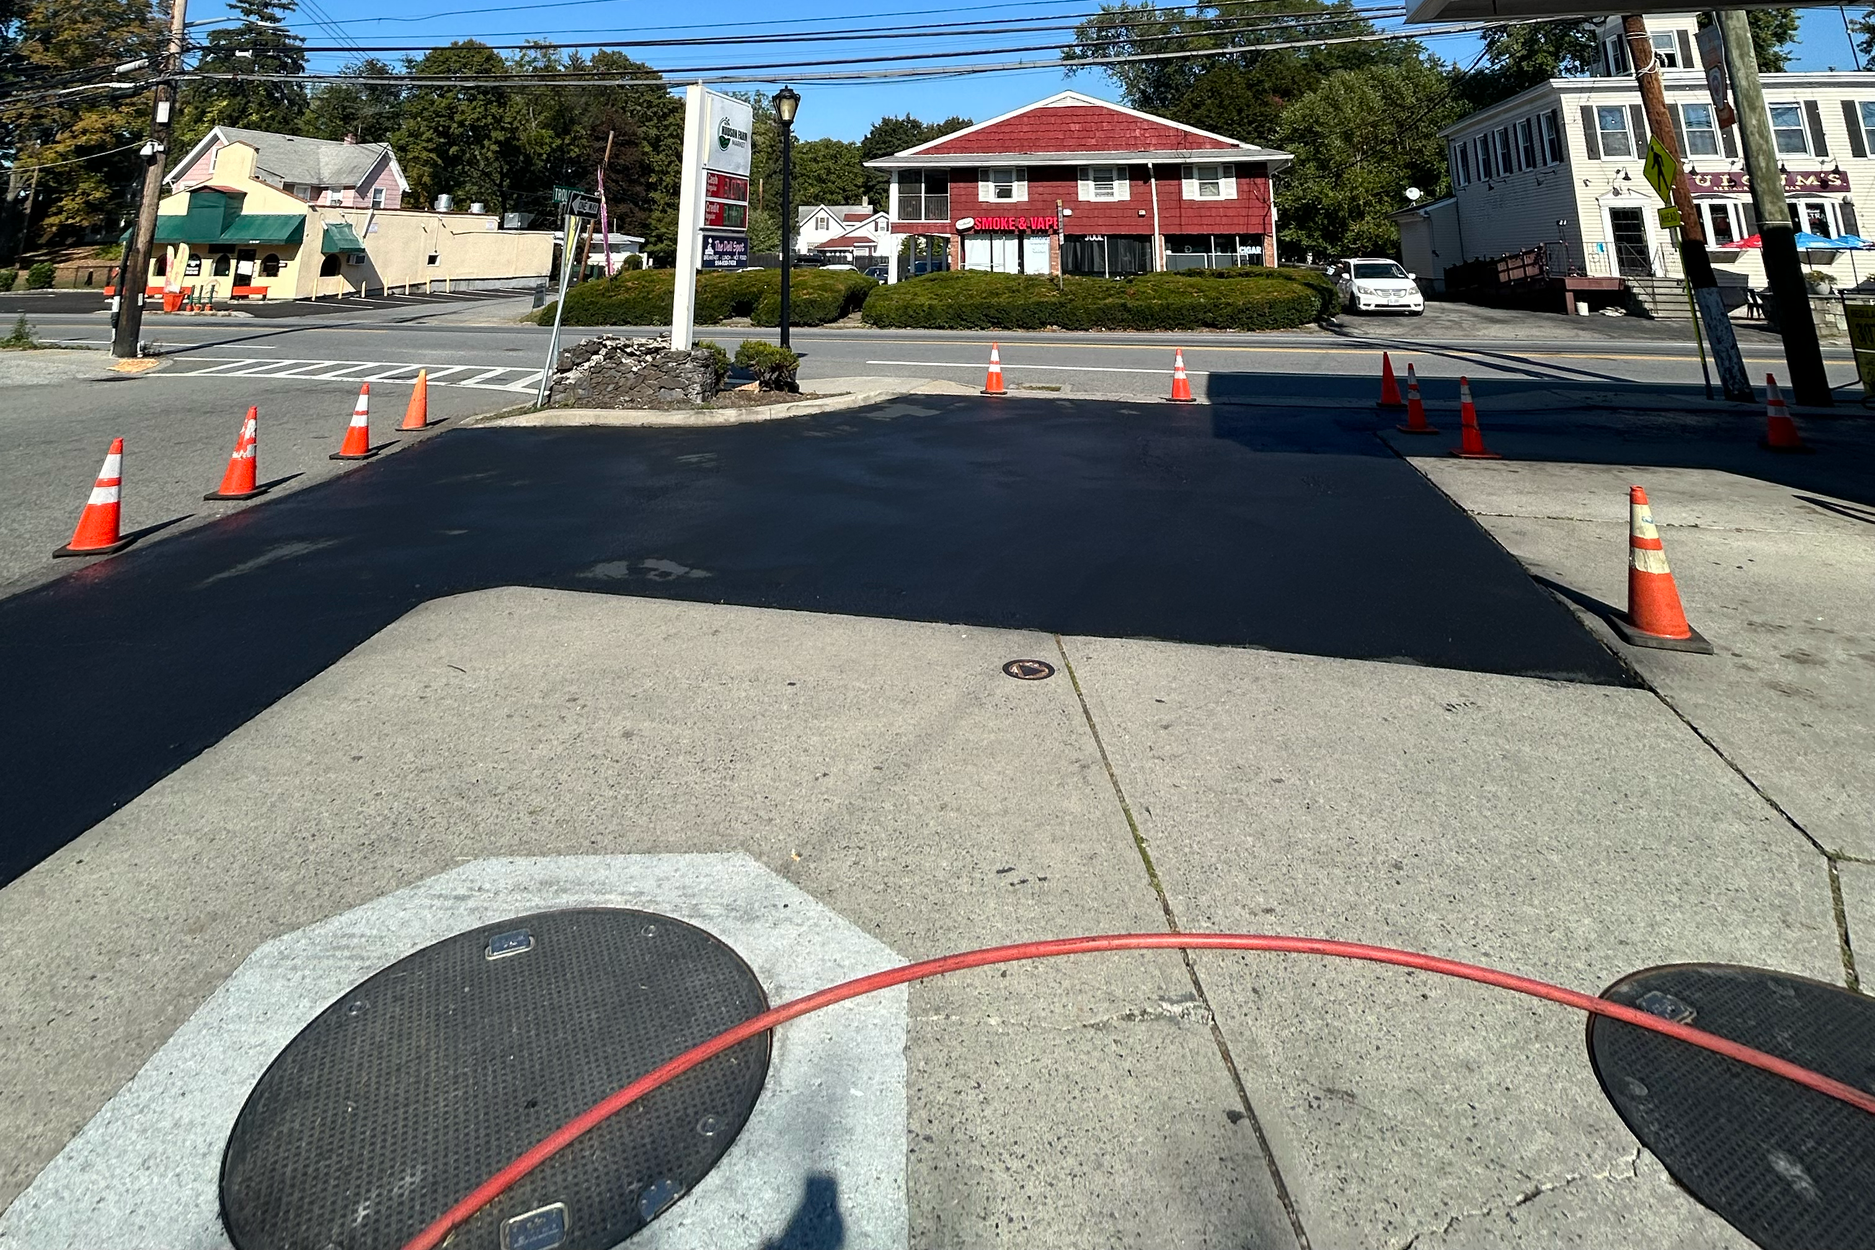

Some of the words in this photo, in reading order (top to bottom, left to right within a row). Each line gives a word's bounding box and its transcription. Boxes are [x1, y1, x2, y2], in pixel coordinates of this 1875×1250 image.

[708, 173, 719, 185] Cash
[578, 200, 588, 211] ONE
[587, 202, 599, 214] WAY
[705, 201, 720, 213] Credit
[1660, 211, 1678, 223] AHEAD
[974, 217, 1016, 230] SMOKE
[1018, 217, 1027, 230] &
[715, 240, 724, 252] The
[733, 241, 745, 256] Spot
[1239, 246, 1263, 255] CIGAR
[1850, 309, 1875, 319] REGULA
